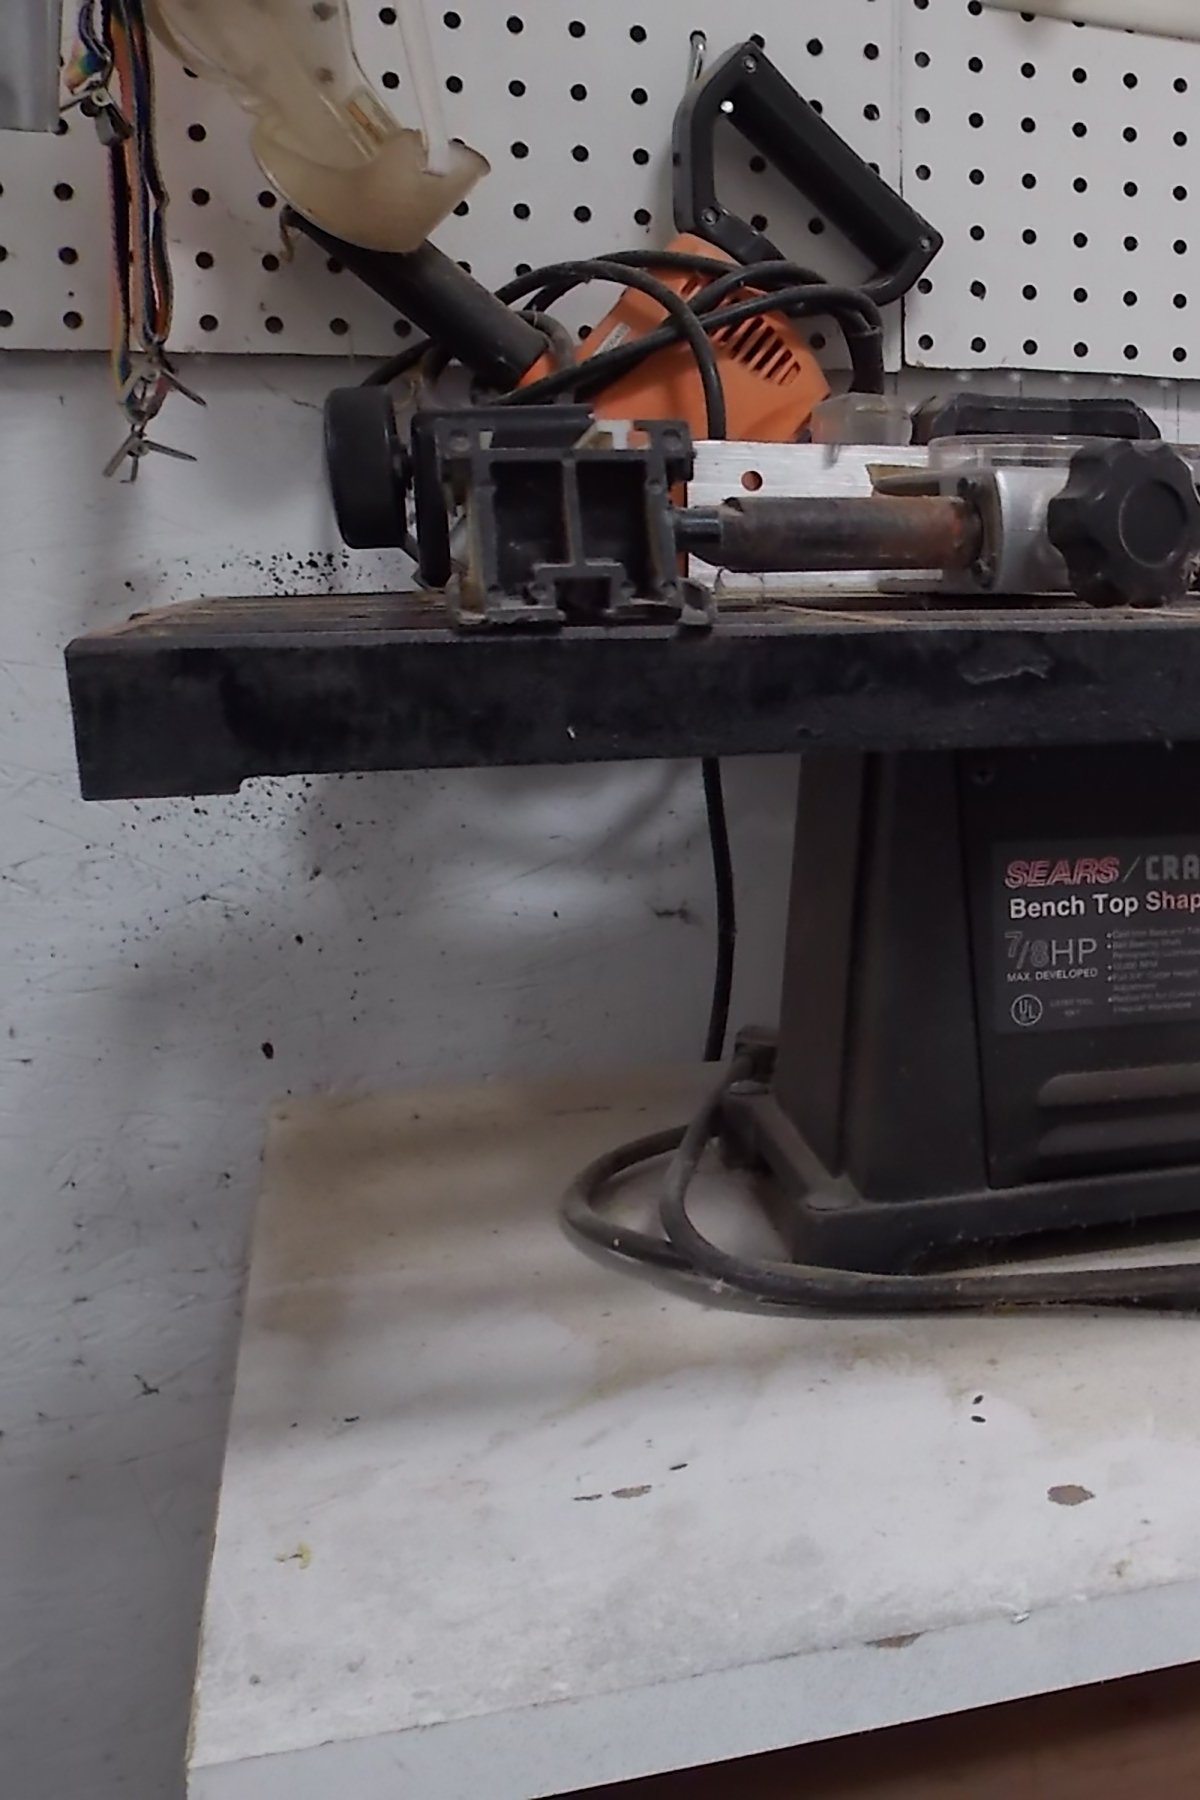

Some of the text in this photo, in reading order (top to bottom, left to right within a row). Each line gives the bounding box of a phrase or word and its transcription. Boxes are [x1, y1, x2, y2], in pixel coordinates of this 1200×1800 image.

[1005, 857, 1120, 888] SEARS
[1010, 896, 1085, 918] Bench
[1092, 893, 1139, 917] Top
[1035, 967, 1098, 980] DEVELOPED
